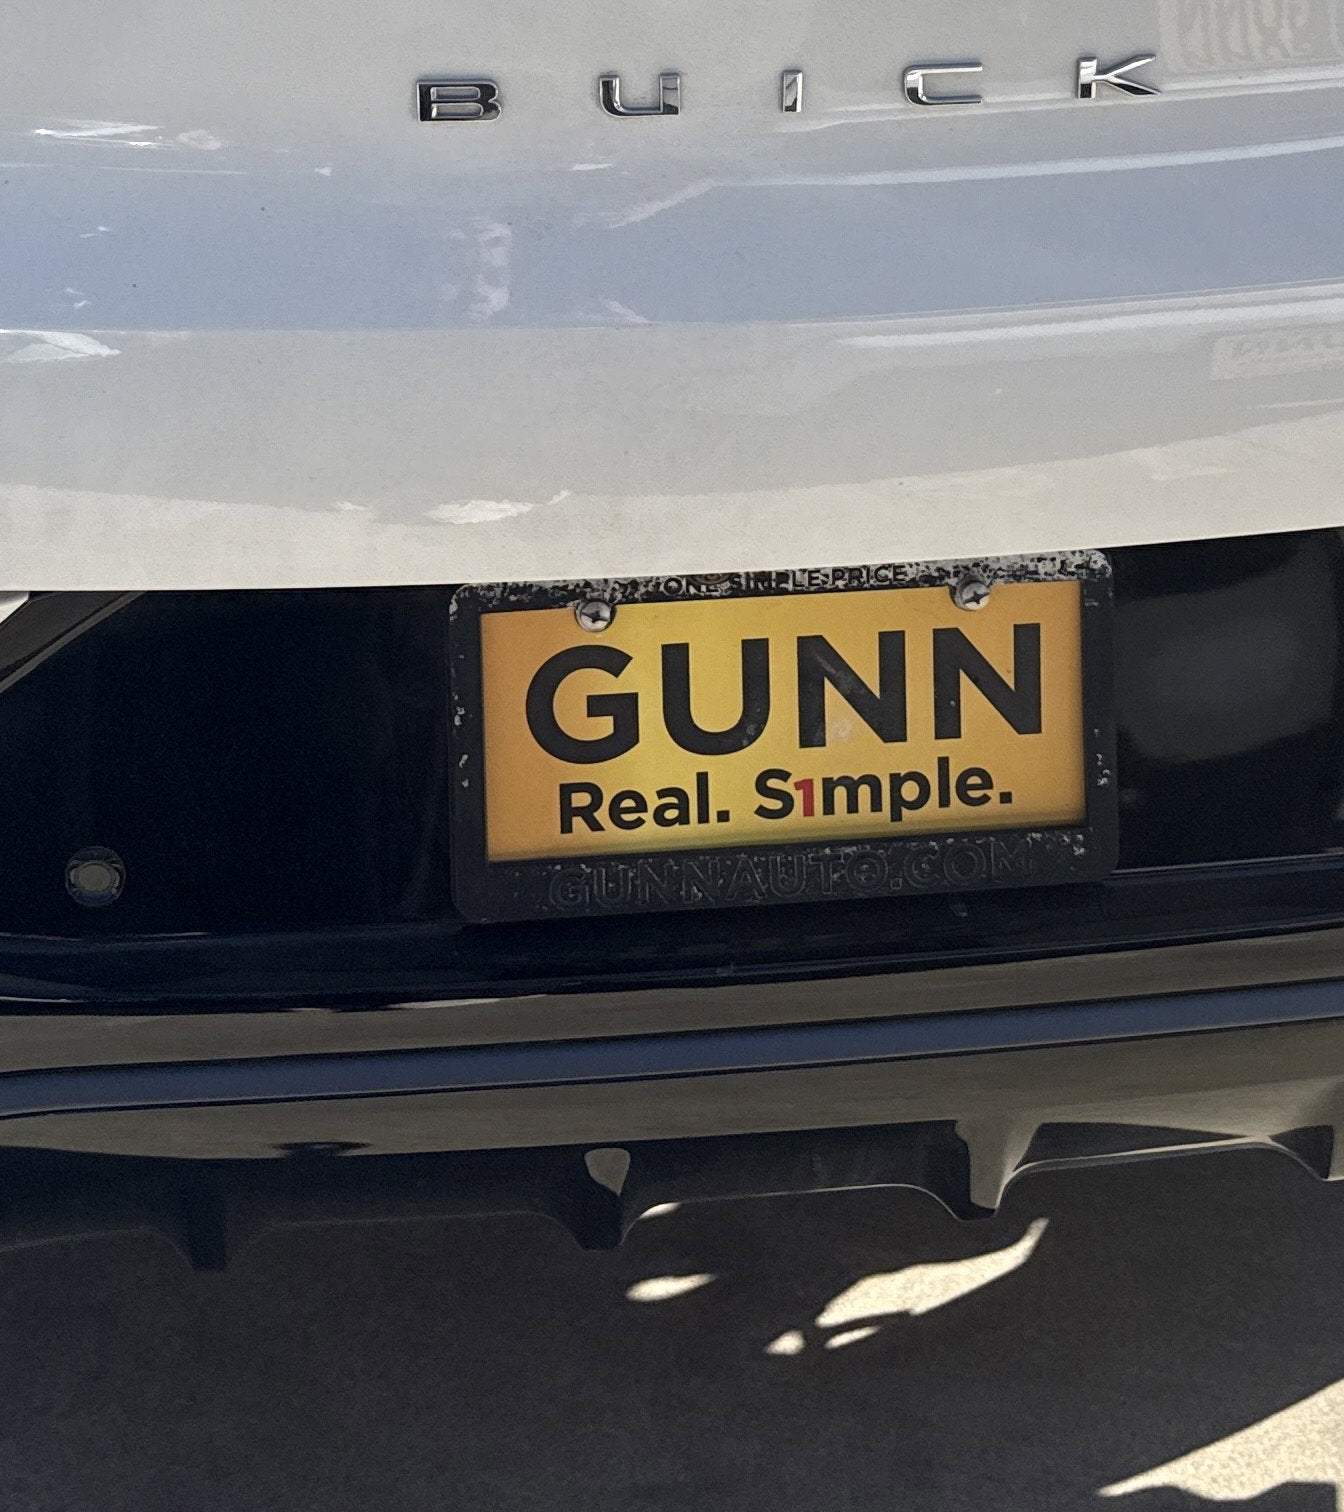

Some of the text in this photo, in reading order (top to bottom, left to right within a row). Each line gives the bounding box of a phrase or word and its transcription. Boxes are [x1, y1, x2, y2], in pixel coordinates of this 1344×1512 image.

[415, 54, 1162, 123] BUICK
[831, 564, 908, 587] PRICE
[525, 622, 1043, 765] GUNN
[559, 771, 731, 835] Real.
[548, 838, 1038, 906] GUNNAUTO.COM
